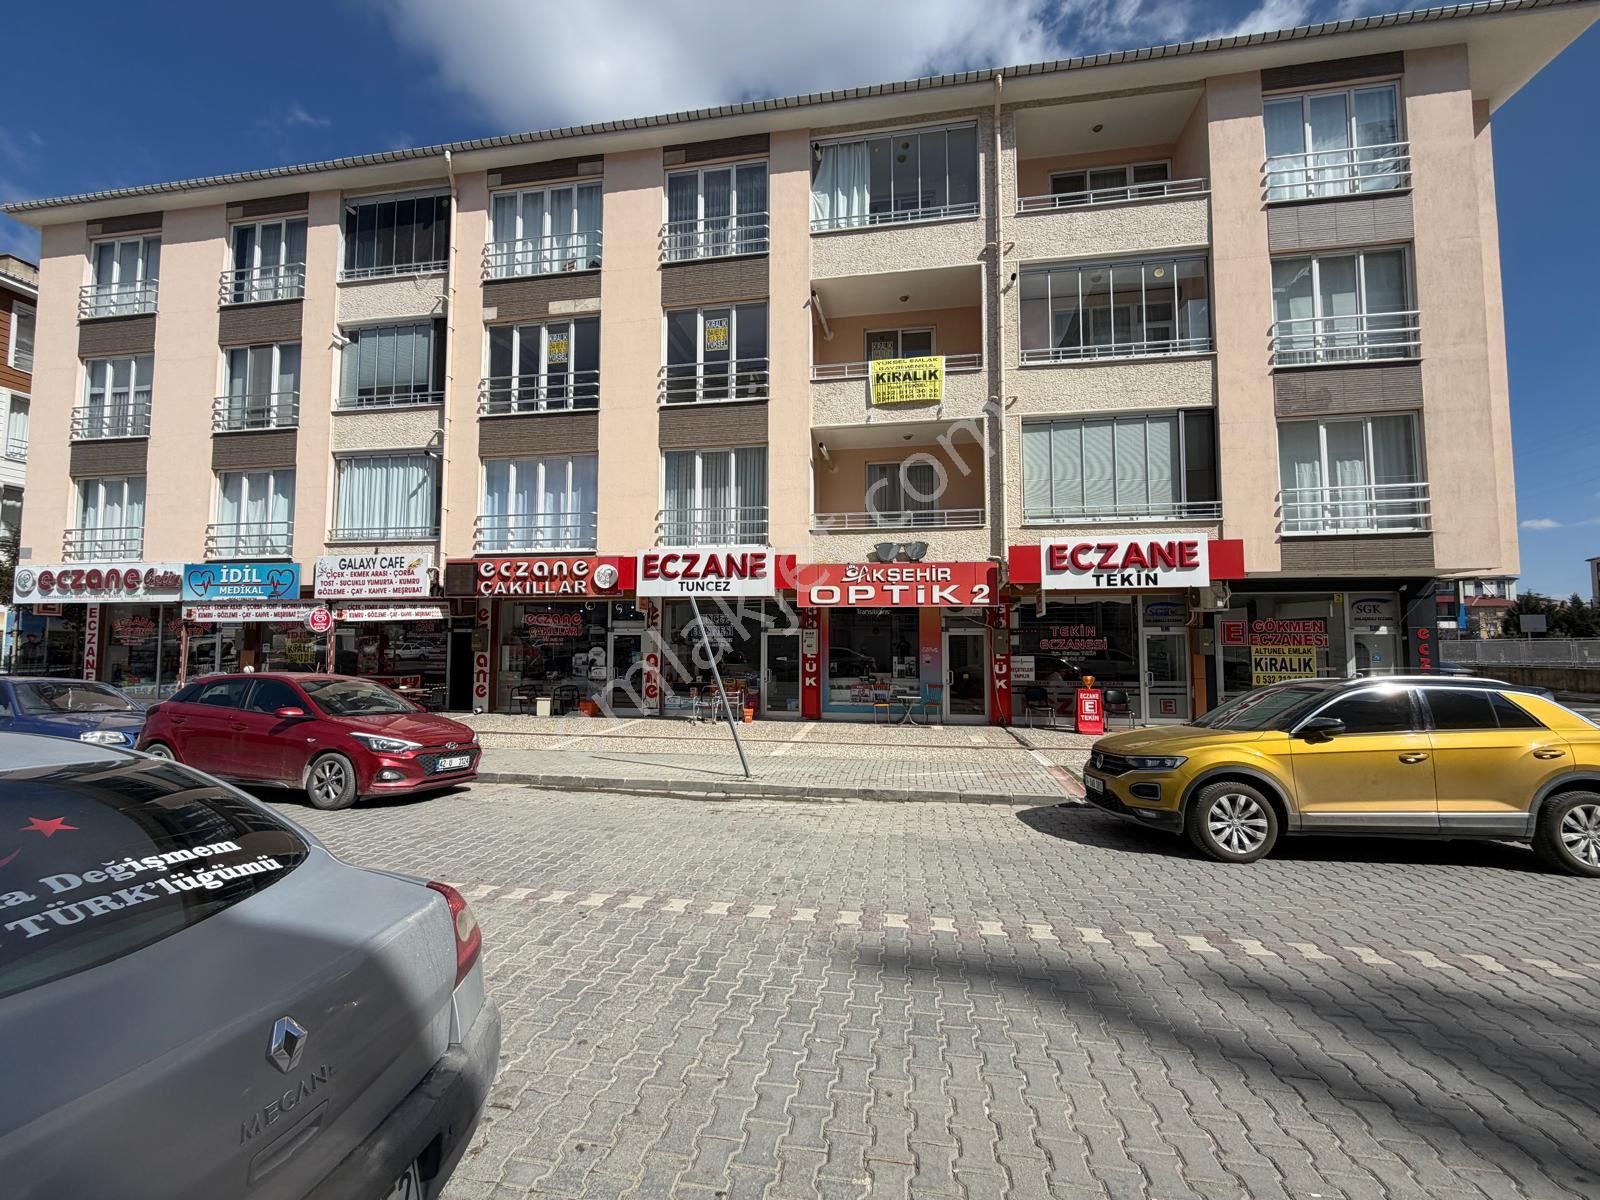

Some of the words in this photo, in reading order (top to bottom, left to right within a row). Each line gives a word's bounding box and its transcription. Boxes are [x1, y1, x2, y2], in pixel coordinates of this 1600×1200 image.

[1048, 540, 1200, 571] ECZANE
[338, 557, 377, 570] GALAXY
[379, 556, 405, 569] CAFE
[479, 560, 589, 577] eczane
[643, 553, 767, 579] ECZANE
[38, 568, 141, 592] eczane
[220, 565, 262, 583] İDİL
[326, 570, 345, 579] ÇİÇEK
[393, 569, 415, 578] ÇORBA
[851, 565, 951, 584] AKŞEHİR
[1092, 570, 1158, 587] TEKİN
[219, 585, 264, 595] MEDİKAL
[340, 579, 366, 587] SUCUKLU
[480, 580, 587, 597] ÇAKILLAR
[678, 581, 731, 592] TUNCEZ
[317, 587, 345, 595] GÖZLEME
[350, 587, 363, 596] ÇAY
[392, 586, 423, 595] MEŞRUBAT
[972, 585, 990, 604] 2
[1357, 604, 1382, 614] SGK
[526, 613, 582, 625] eczane
[1252, 618, 1324, 633] GÖKMEN
[1050, 624, 1096, 637] TEKİN
[1225, 623, 1243, 642] E
[85, 607, 98, 680] ECZANE
[1255, 647, 1287, 655] ALTUNEL
[1288, 647, 1313, 655] EMLAK
[1256, 675, 1261, 684] 0
[1263, 675, 1276, 684] 532
[1085, 701, 1095, 712] E
[1081, 713, 1100, 722] TEKİN
[0, 890, 37, 910] a
[38, 840, 242, 895] Değişmem
